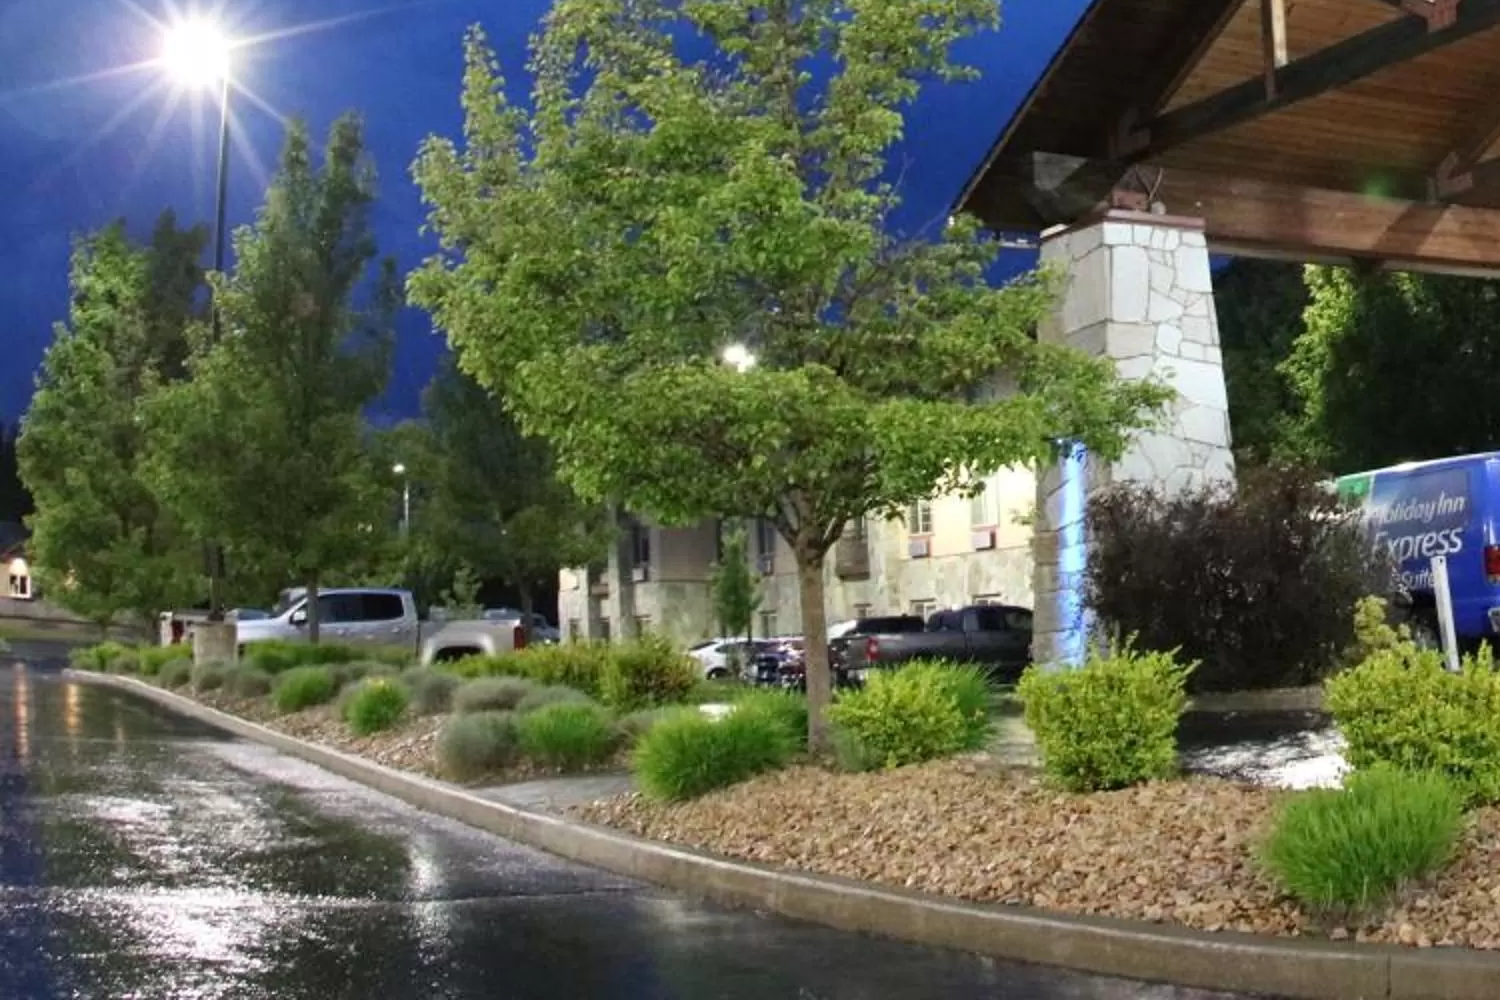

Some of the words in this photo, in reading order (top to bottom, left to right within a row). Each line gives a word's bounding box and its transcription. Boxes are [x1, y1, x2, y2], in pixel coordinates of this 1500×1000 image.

[1437, 489, 1465, 515] Inn
[1371, 527, 1464, 563] Express
[1401, 567, 1438, 591] Suite
